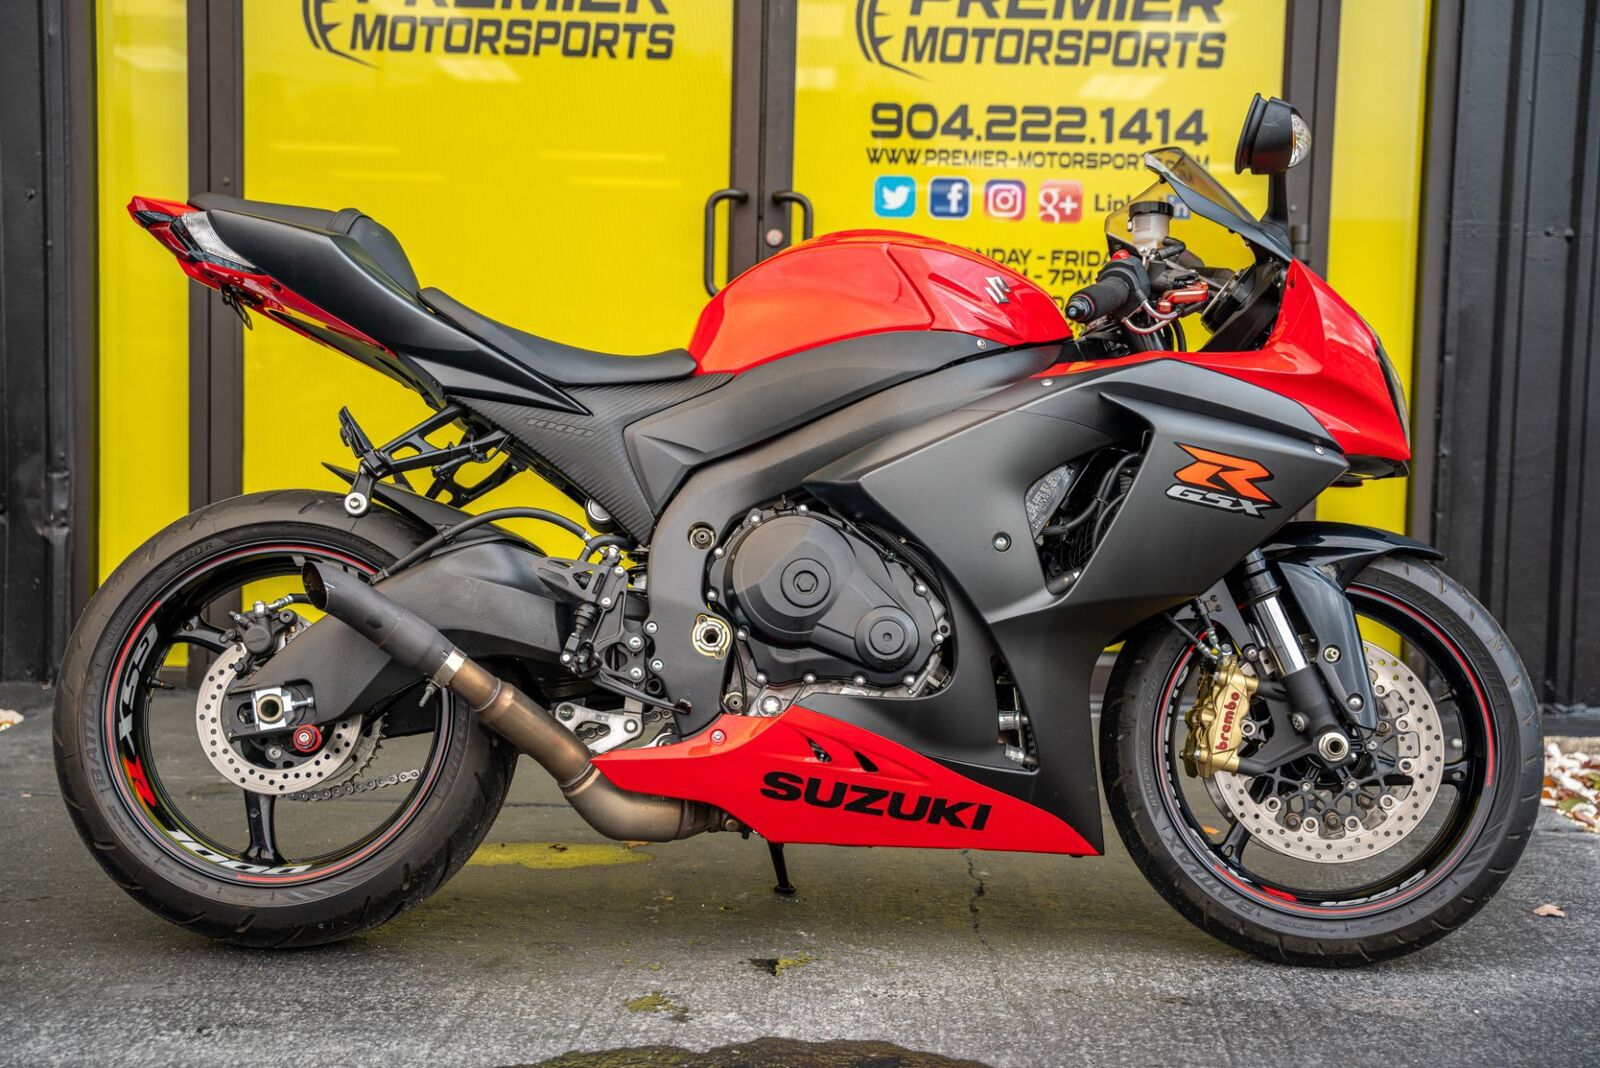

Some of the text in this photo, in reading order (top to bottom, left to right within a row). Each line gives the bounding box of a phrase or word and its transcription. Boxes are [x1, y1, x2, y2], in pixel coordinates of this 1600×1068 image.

[350, 12, 675, 60] MOTORSPORTS
[901, 25, 1226, 69] MOTORSPORTS
[870, 102, 1209, 145] 904.222.1414
[1049, 269, 1092, 286] 7PM
[1214, 691, 1241, 751] brembo
[760, 771, 993, 831] SUZUKI
[1165, 834, 1253, 916] BATTLAX
